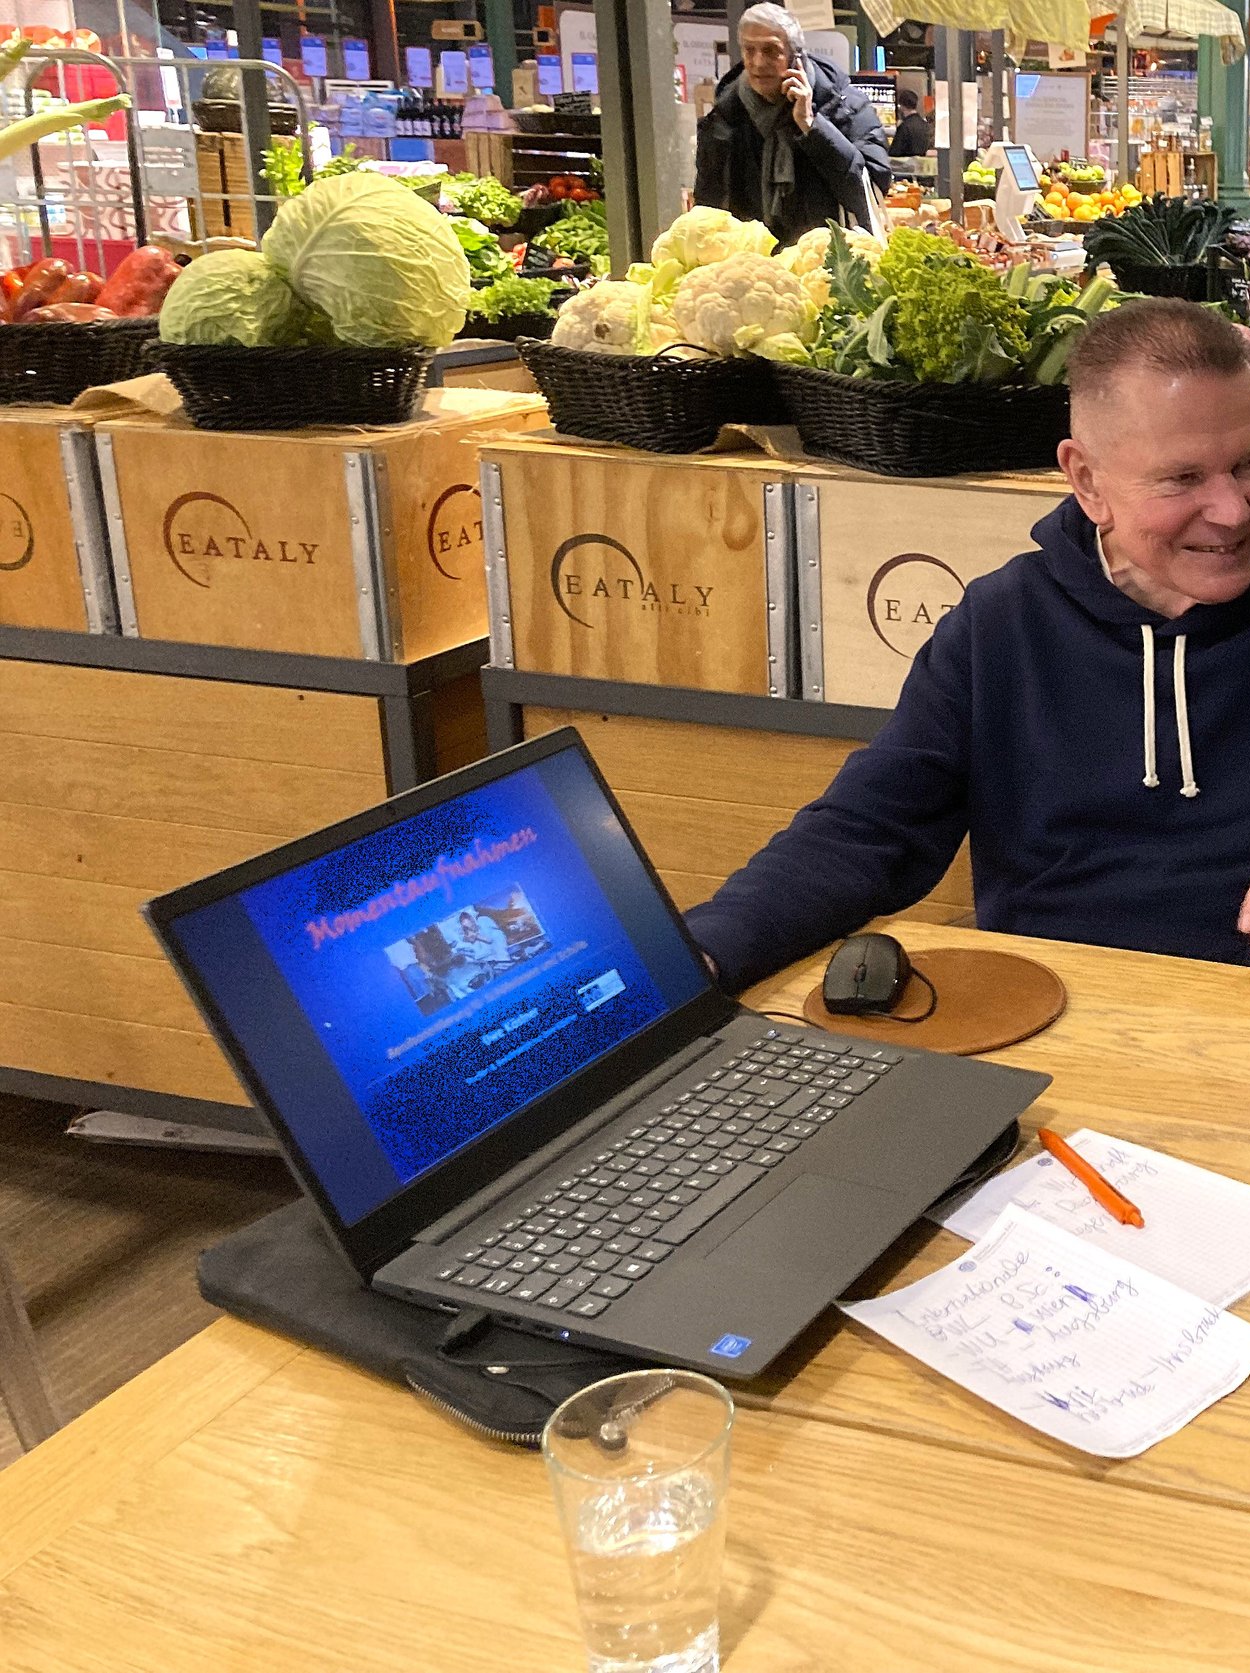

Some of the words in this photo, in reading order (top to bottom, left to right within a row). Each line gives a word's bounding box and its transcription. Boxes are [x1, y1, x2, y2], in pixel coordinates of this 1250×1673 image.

[177, 533, 319, 564] EATALY
[563, 573, 714, 607] EATALY
[306, 827, 538, 949] Momentaufnahmen
